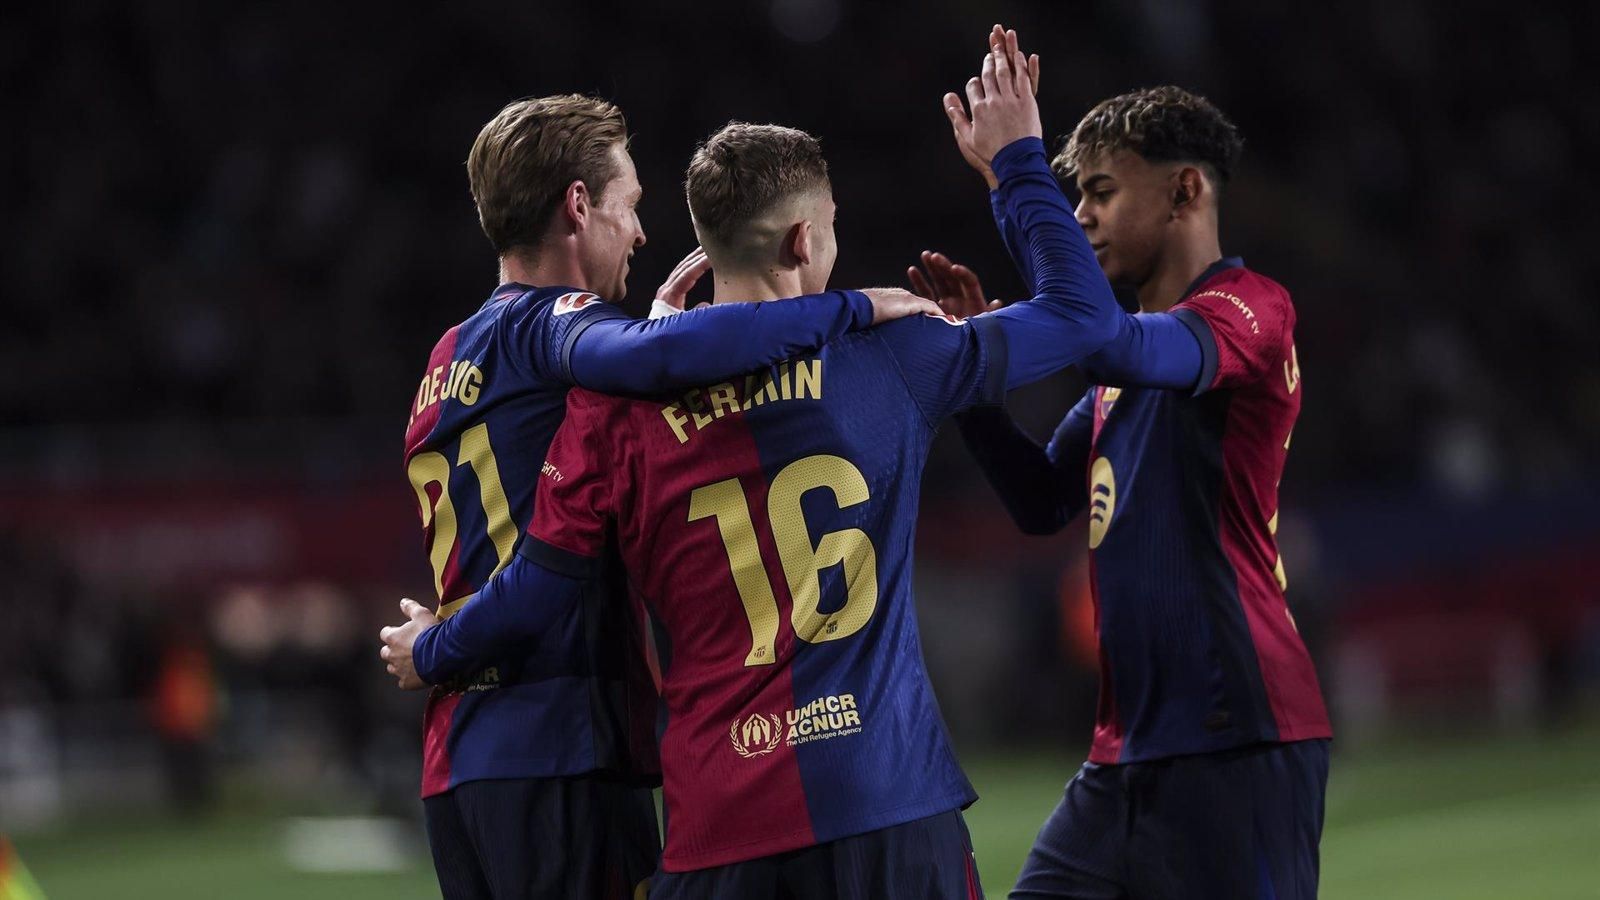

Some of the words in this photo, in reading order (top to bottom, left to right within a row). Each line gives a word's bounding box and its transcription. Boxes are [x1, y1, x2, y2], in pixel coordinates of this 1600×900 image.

[416, 365, 444, 415] DE
[407, 422, 519, 621] 21
[688, 454, 878, 667] 16
[785, 693, 857, 725] UNHCR
[785, 710, 862, 741] ACNUR
[786, 739, 798, 747] The
[798, 734, 810, 744] UN
[809, 731, 837, 742] Refugee
[837, 726, 862, 737] Agency
